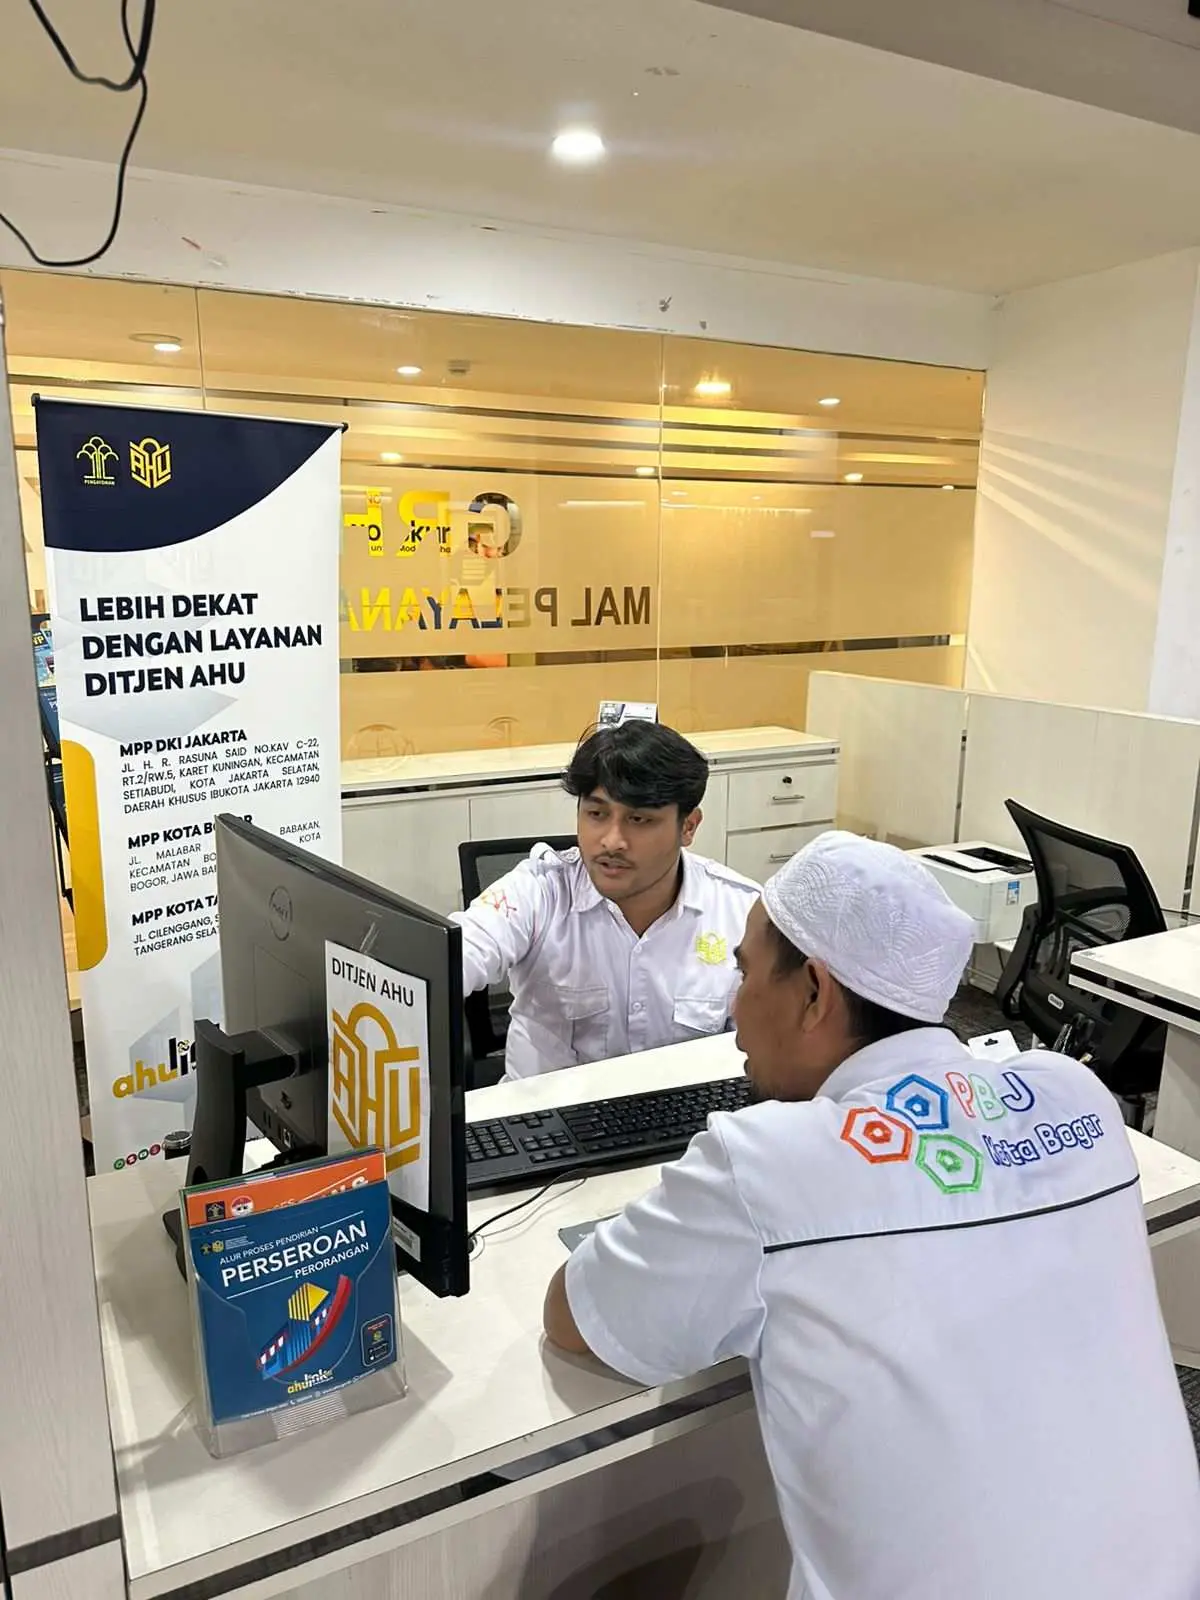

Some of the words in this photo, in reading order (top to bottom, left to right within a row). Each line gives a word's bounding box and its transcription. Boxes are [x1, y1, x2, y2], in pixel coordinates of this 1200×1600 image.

[80, 596, 164, 622] LEBIH
[172, 593, 258, 618] DEKAT
[82, 630, 202, 660] DENGAN
[210, 625, 322, 651] LAYANAN
[85, 666, 184, 697] DITJEN
[190, 662, 245, 688] AHU
[120, 741, 153, 757] MPP
[155, 737, 182, 752] DKI
[185, 729, 247, 748] JAKARTA
[143, 760, 153, 770] H.
[162, 757, 171, 767] R.
[179, 751, 218, 765] RASUNA
[225, 747, 247, 758] SAID
[254, 742, 289, 754] NO.KAV
[122, 769, 176, 786] RT.2/RW.5,
[179, 765, 208, 778] KARET
[212, 758, 263, 772] KUNINGAN,
[266, 750, 319, 765] KECAMATAN
[123, 784, 176, 800] SETIABUDI,
[190, 777, 216, 789] KOTA
[229, 769, 269, 783] JAKARTA
[124, 799, 165, 814] DAERAH
[168, 792, 207, 806] KHUSUS
[210, 785, 250, 799] IBUKOTA
[253, 778, 293, 792] JAKARTA
[296, 774, 320, 785] 12940
[128, 832, 160, 849] MPP
[163, 825, 202, 842] KOTA
[156, 844, 201, 860] MALABAR
[129, 858, 190, 879] KECAMATAN
[203, 853, 217, 863] BO
[299, 832, 321, 843] KOTA
[130, 876, 169, 892] BOGOR,
[171, 869, 199, 883] JAWA
[201, 865, 217, 876] BA
[132, 907, 163, 926] MPP
[166, 898, 204, 917] KOTA
[148, 916, 214, 940] CILENGGANG,
[134, 933, 194, 956] TANGERANG
[195, 926, 219, 940] SELA
[332, 957, 377, 993] DITJEN
[380, 978, 415, 1007] AHU
[112, 1037, 197, 1098] ahuli
[945, 1071, 1035, 1121] PBJ
[1034, 1113, 1105, 1155] Bogor
[219, 1253, 242, 1265] ALUR
[243, 1241, 275, 1260] PROSES
[276, 1226, 319, 1246] PENDIRIAN
[221, 1219, 368, 1288] PERSEROAN
[294, 1241, 369, 1279] PERORANGAN
